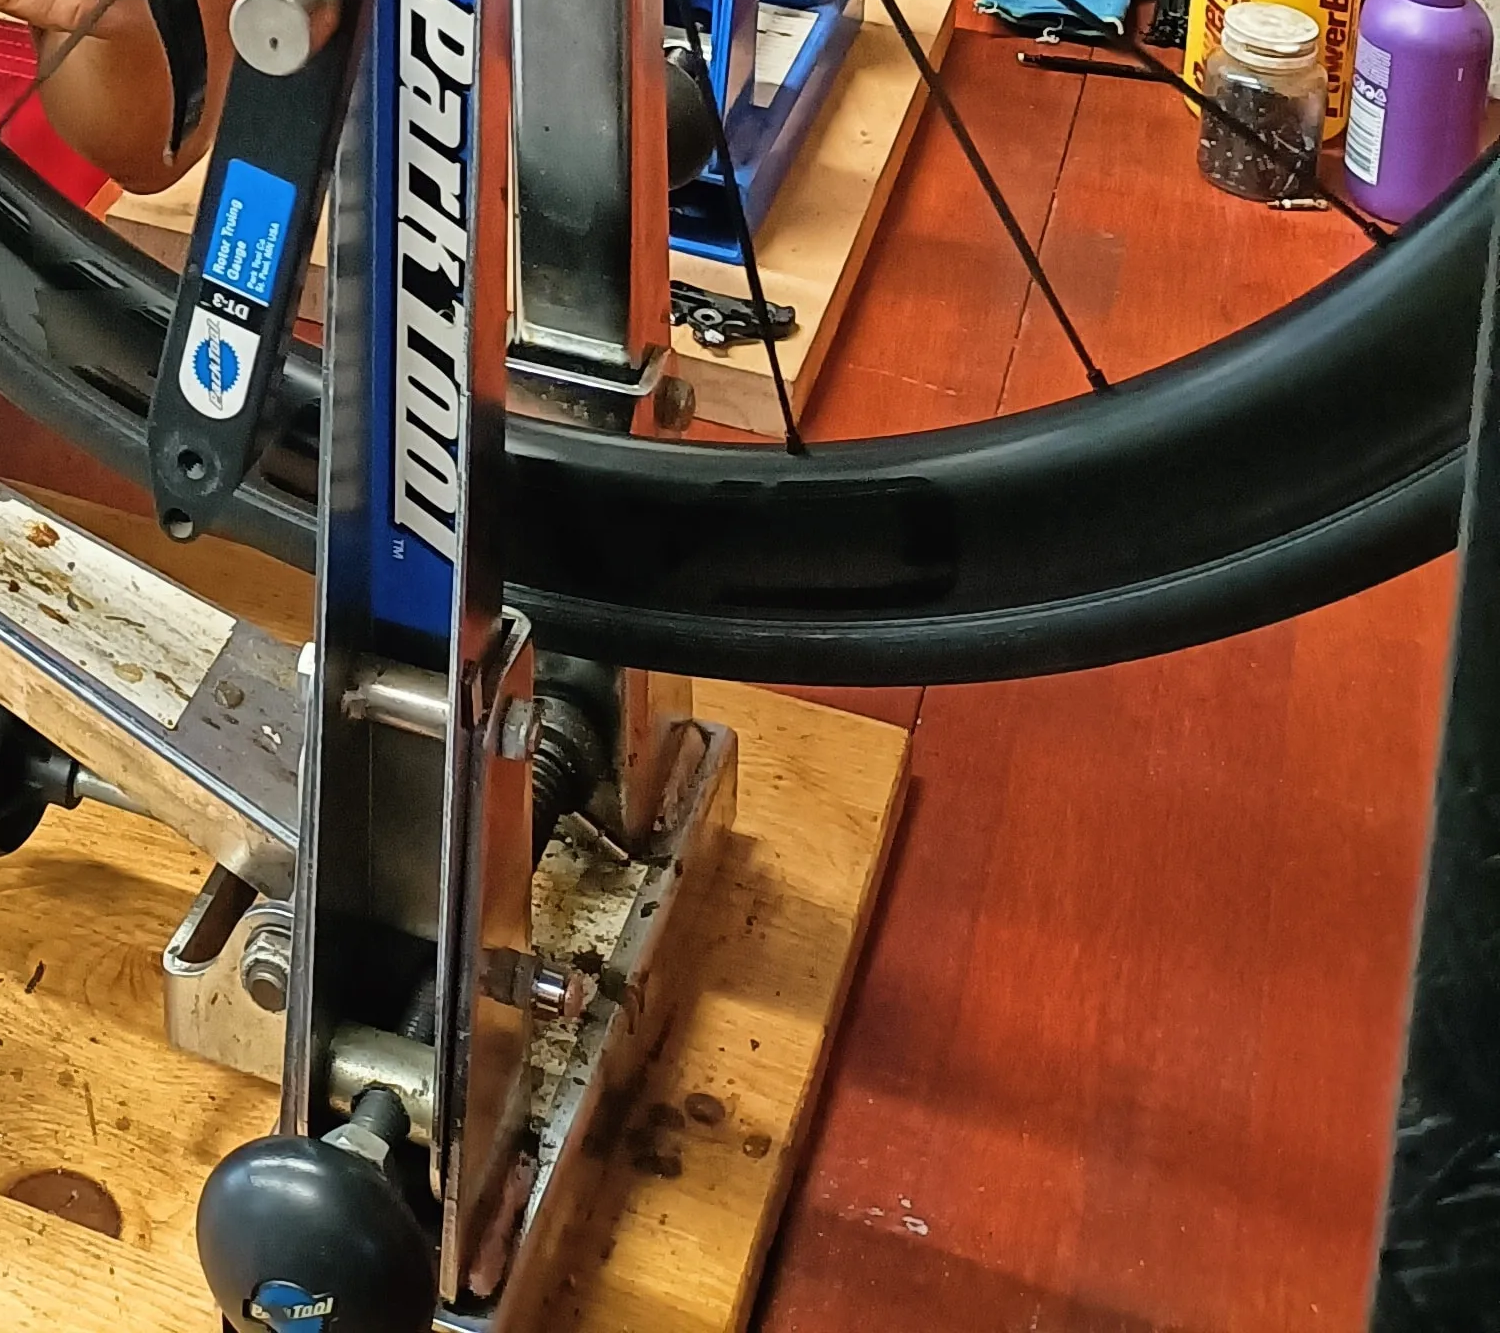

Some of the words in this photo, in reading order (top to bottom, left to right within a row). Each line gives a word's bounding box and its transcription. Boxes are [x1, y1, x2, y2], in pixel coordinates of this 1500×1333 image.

[221, 198, 244, 235] Truing
[212, 236, 231, 276] Rotor
[227, 240, 248, 282] Gauge
[211, 292, 251, 321] DT-3
